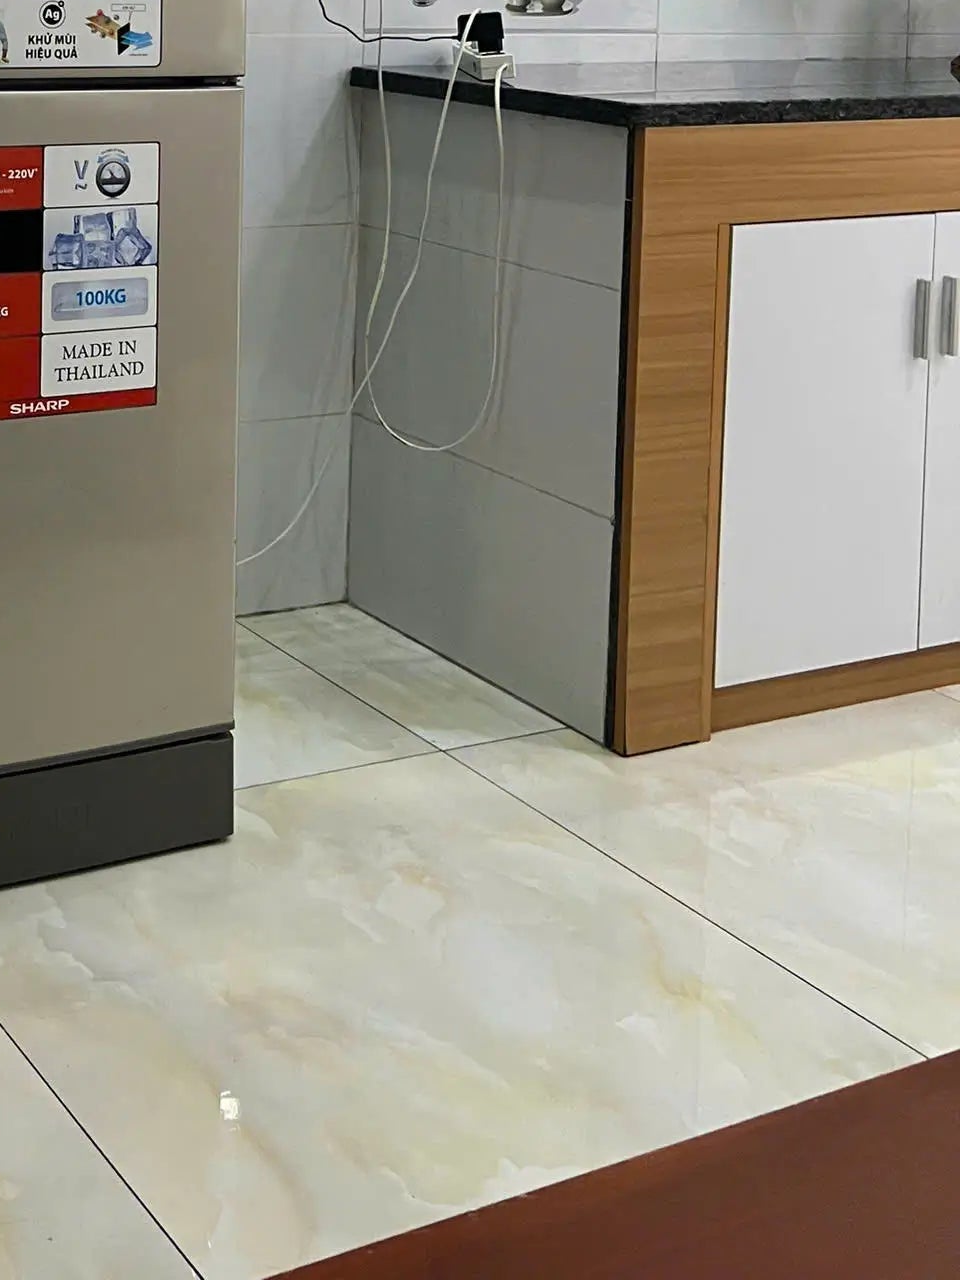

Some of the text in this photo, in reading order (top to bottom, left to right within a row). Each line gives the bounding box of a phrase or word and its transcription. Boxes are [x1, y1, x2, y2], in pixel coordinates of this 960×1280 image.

[45, 9, 60, 22] Ag
[28, 32, 76, 45] KHỬ MÙI
[26, 45, 78, 62] HIỆU QUẢ
[76, 288, 127, 307] 100KG
[62, 340, 138, 360] MADE IN
[55, 361, 145, 382] THAILAND
[10, 400, 70, 414] SHARP
